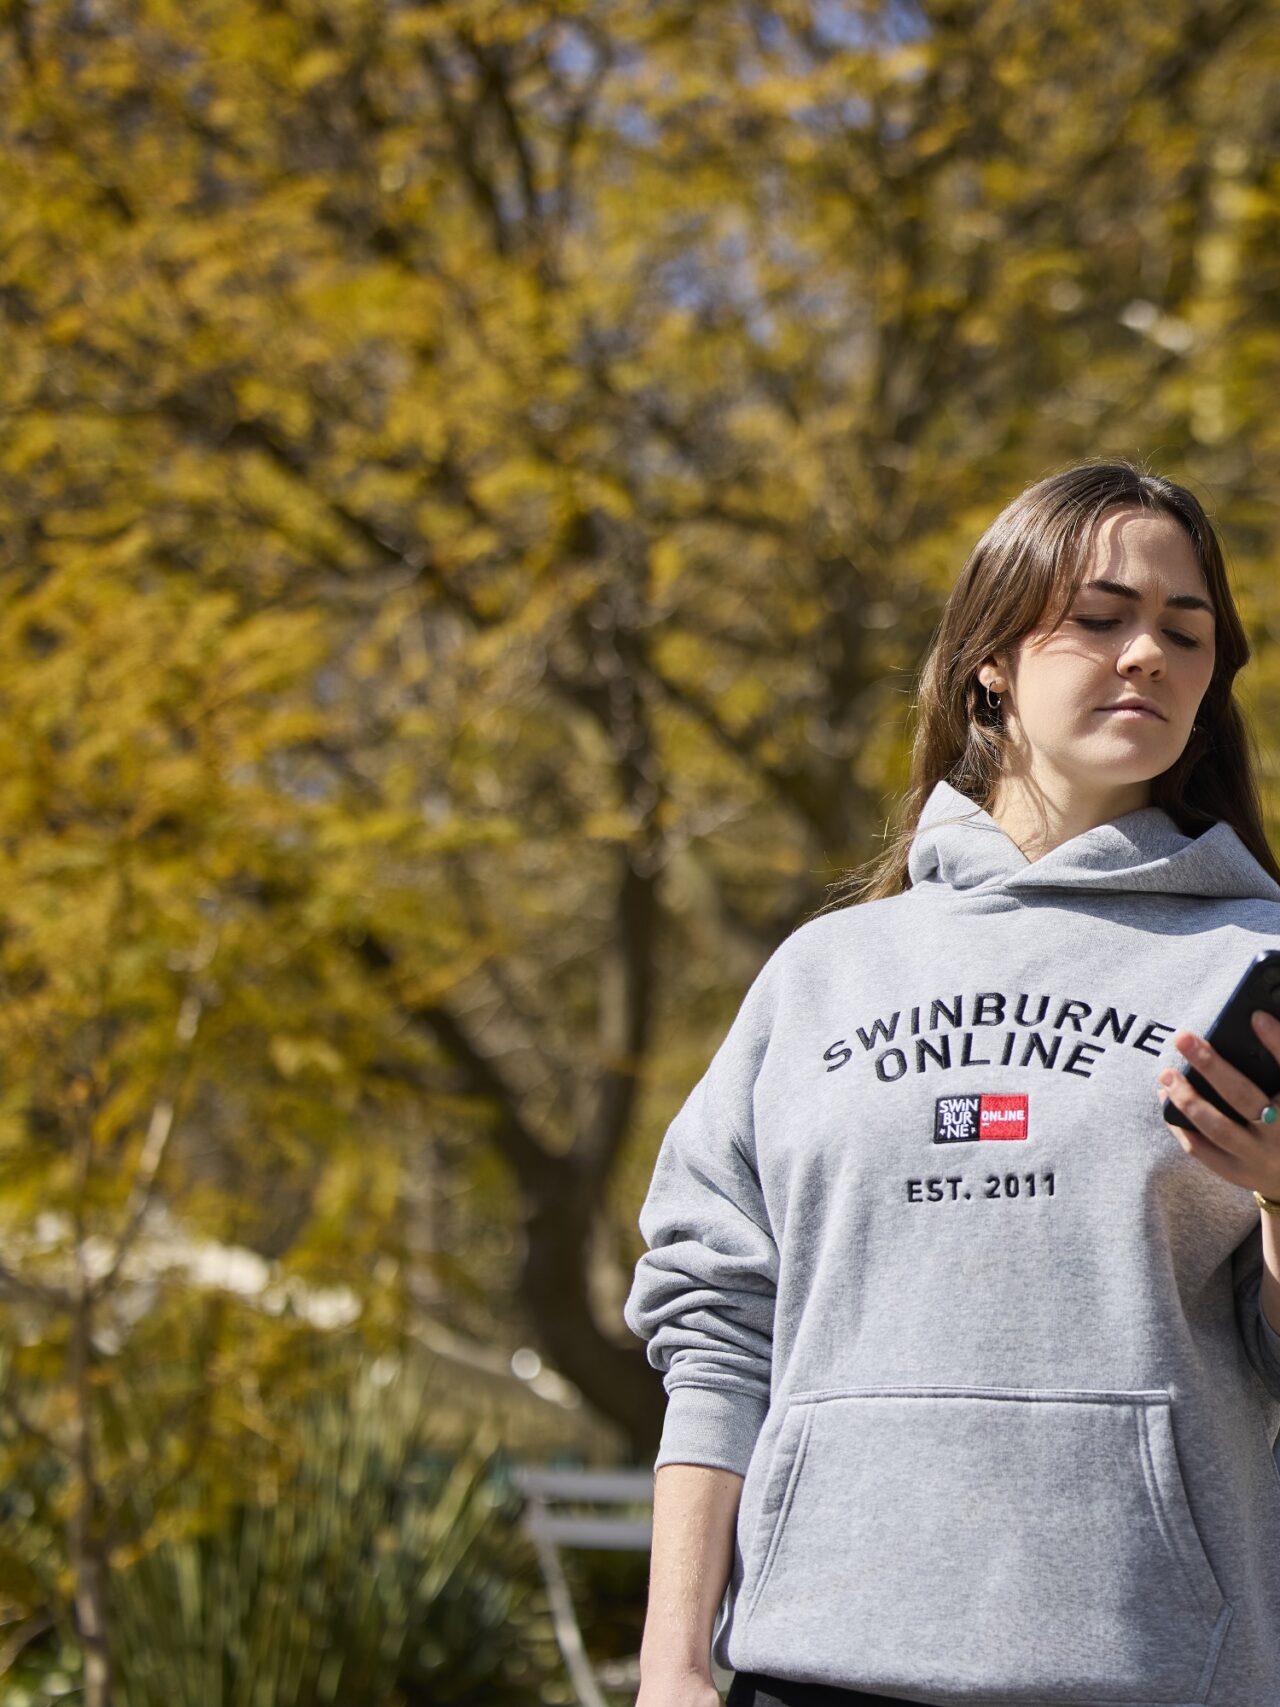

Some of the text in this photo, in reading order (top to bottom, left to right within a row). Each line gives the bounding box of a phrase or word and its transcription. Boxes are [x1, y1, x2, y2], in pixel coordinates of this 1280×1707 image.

[823, 992, 1177, 1072] SWINBURNE
[875, 1032, 1106, 1082] ONLINE
[943, 1112, 973, 1126] BUR
[981, 1110, 1025, 1123] ONLINE
[907, 1173, 1055, 1203] EST. 2011
